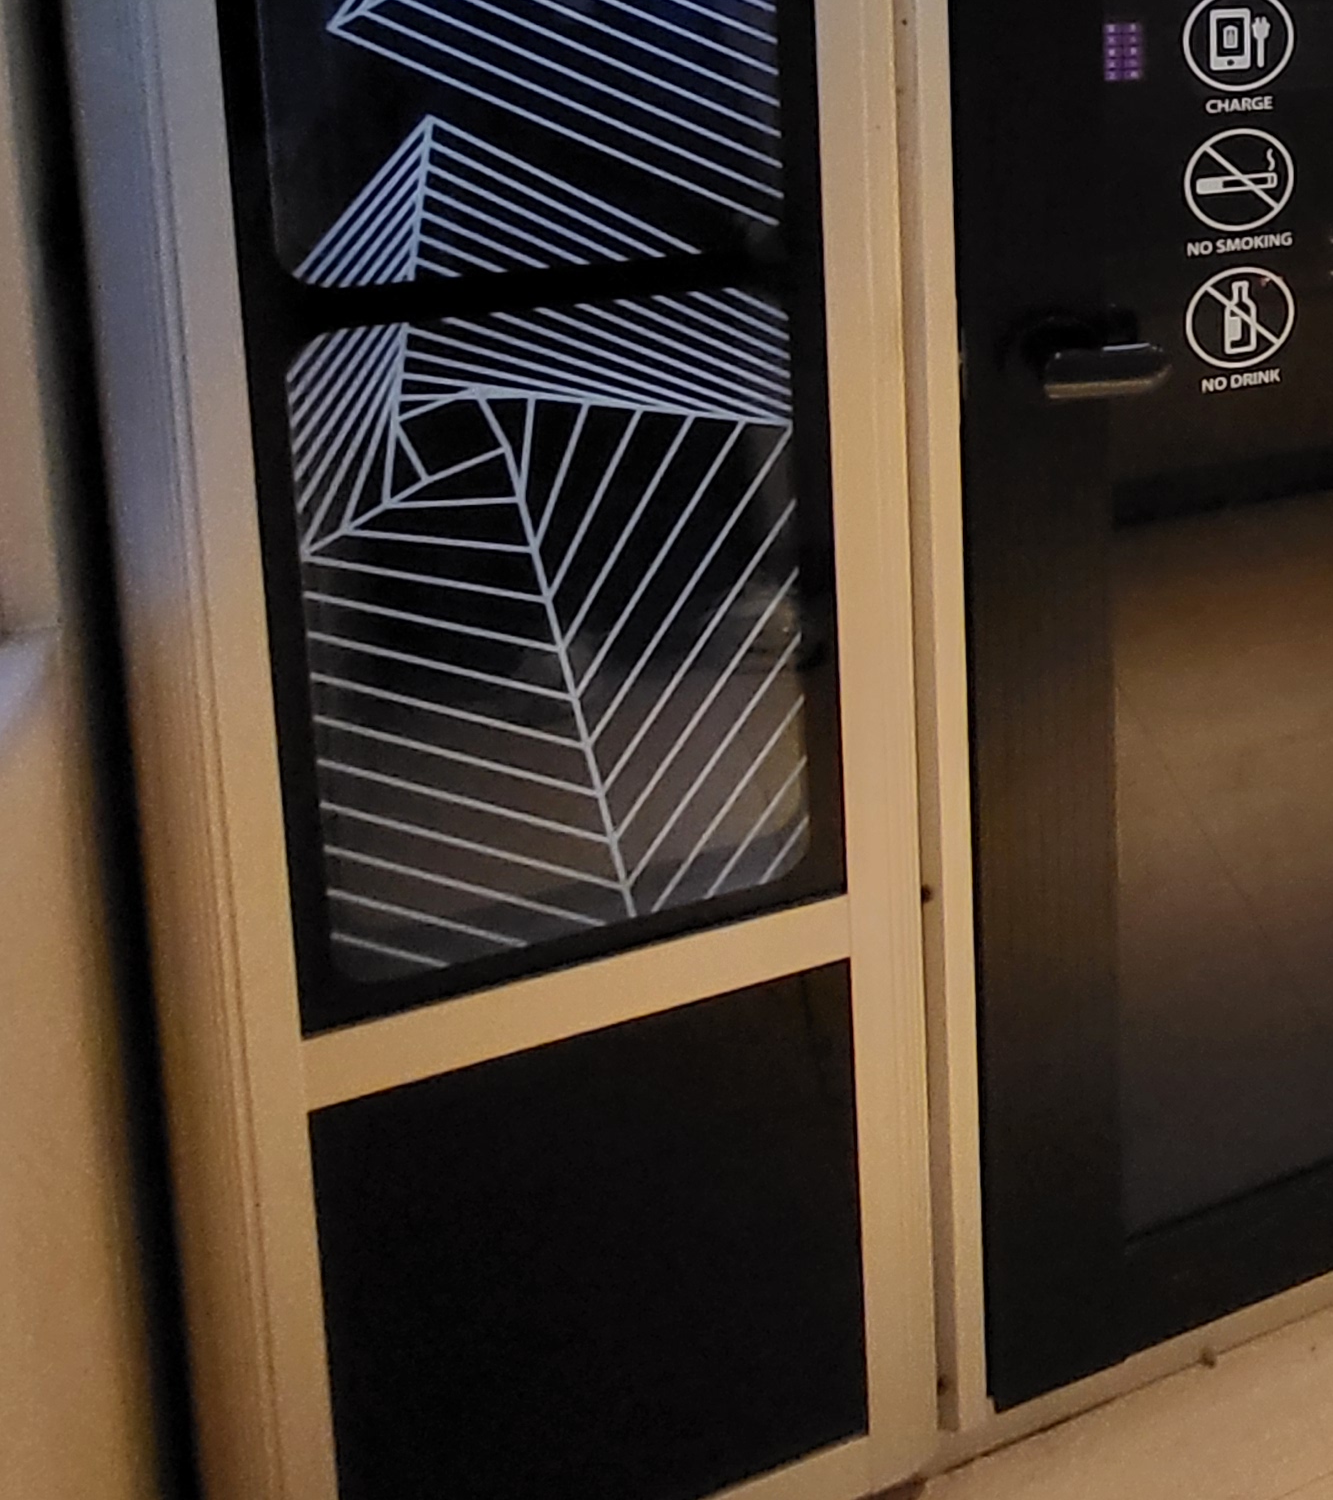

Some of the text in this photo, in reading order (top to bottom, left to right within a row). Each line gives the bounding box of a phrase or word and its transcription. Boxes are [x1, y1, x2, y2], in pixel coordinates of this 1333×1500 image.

[1205, 96, 1273, 114] CHARGE
[1186, 232, 1293, 257] NO SMOKING
[1201, 368, 1281, 393] NO DRINK
